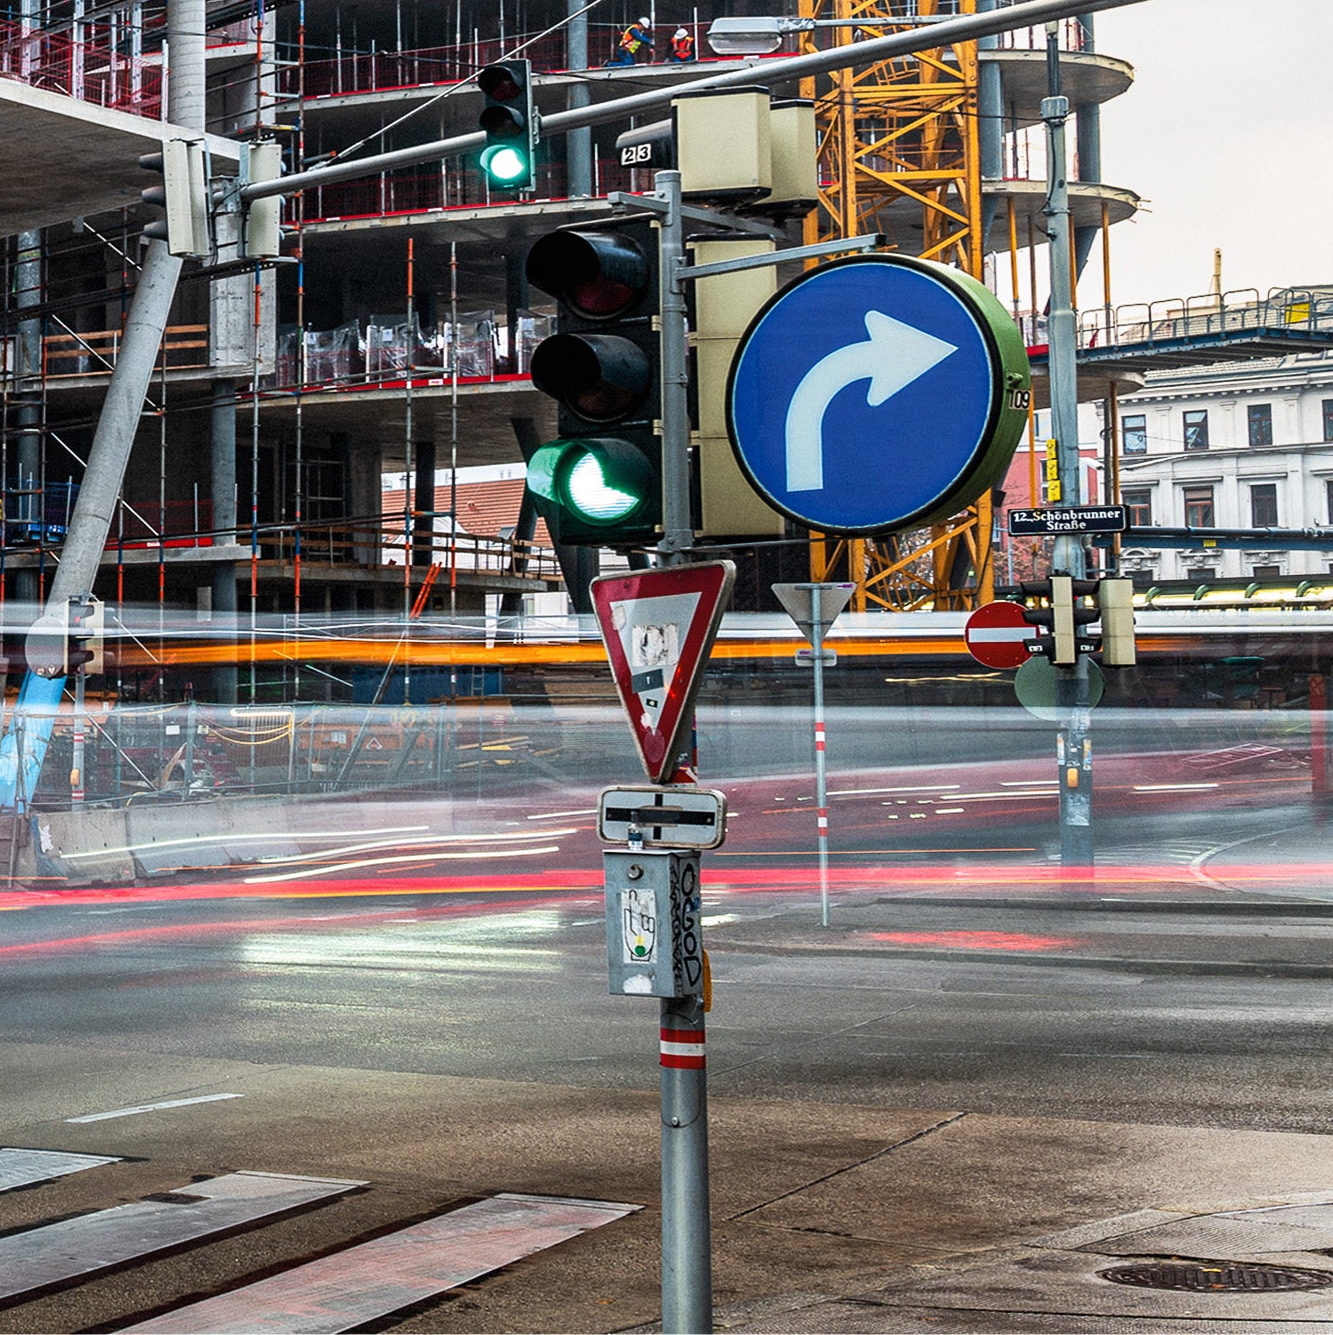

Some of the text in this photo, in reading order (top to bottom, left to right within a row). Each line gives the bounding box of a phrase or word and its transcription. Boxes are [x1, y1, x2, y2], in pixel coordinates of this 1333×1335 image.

[624, 146, 649, 163] 23
[1009, 389, 1030, 409] 109
[1032, 510, 1121, 522] Schönbrunner
[1046, 520, 1087, 531] Straße
